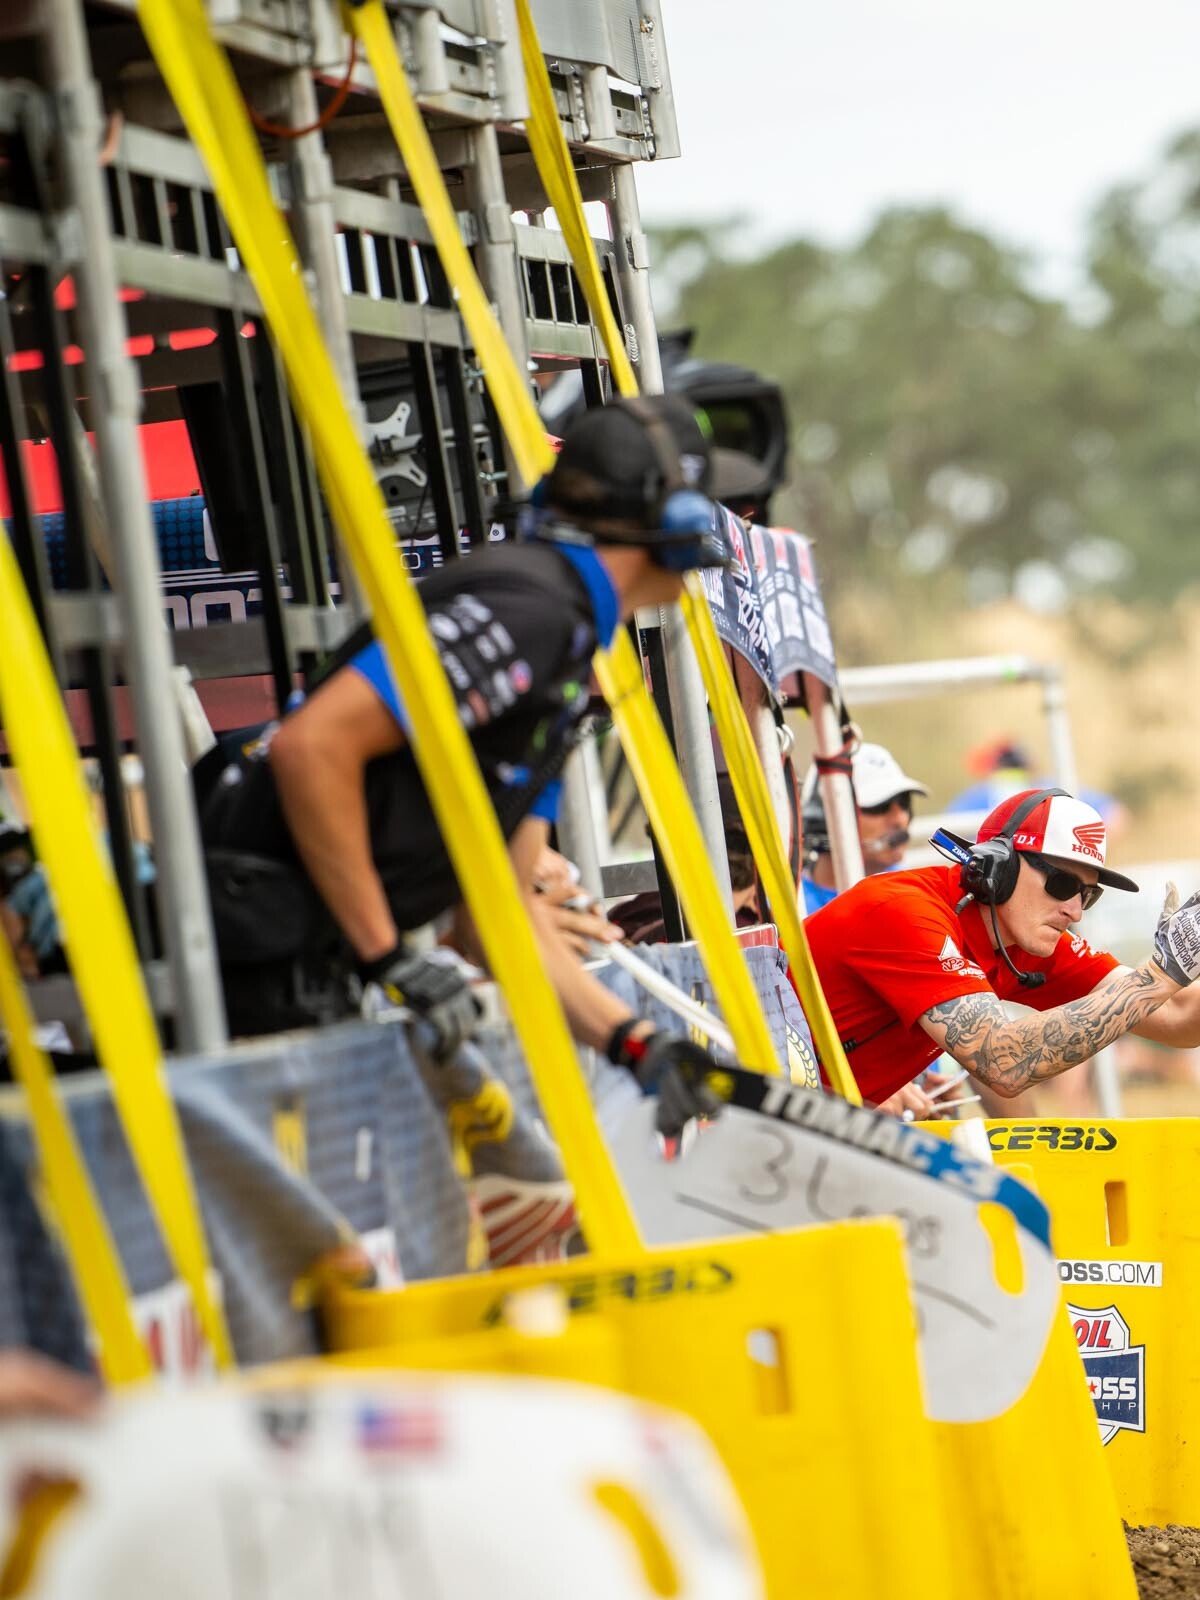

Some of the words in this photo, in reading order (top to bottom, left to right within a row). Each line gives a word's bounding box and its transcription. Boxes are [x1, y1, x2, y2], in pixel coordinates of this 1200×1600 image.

[761, 1076, 938, 1165] TOMAC
[1058, 1261, 1155, 1284] OSS.COM
[1101, 1402, 1137, 1411] HIP
